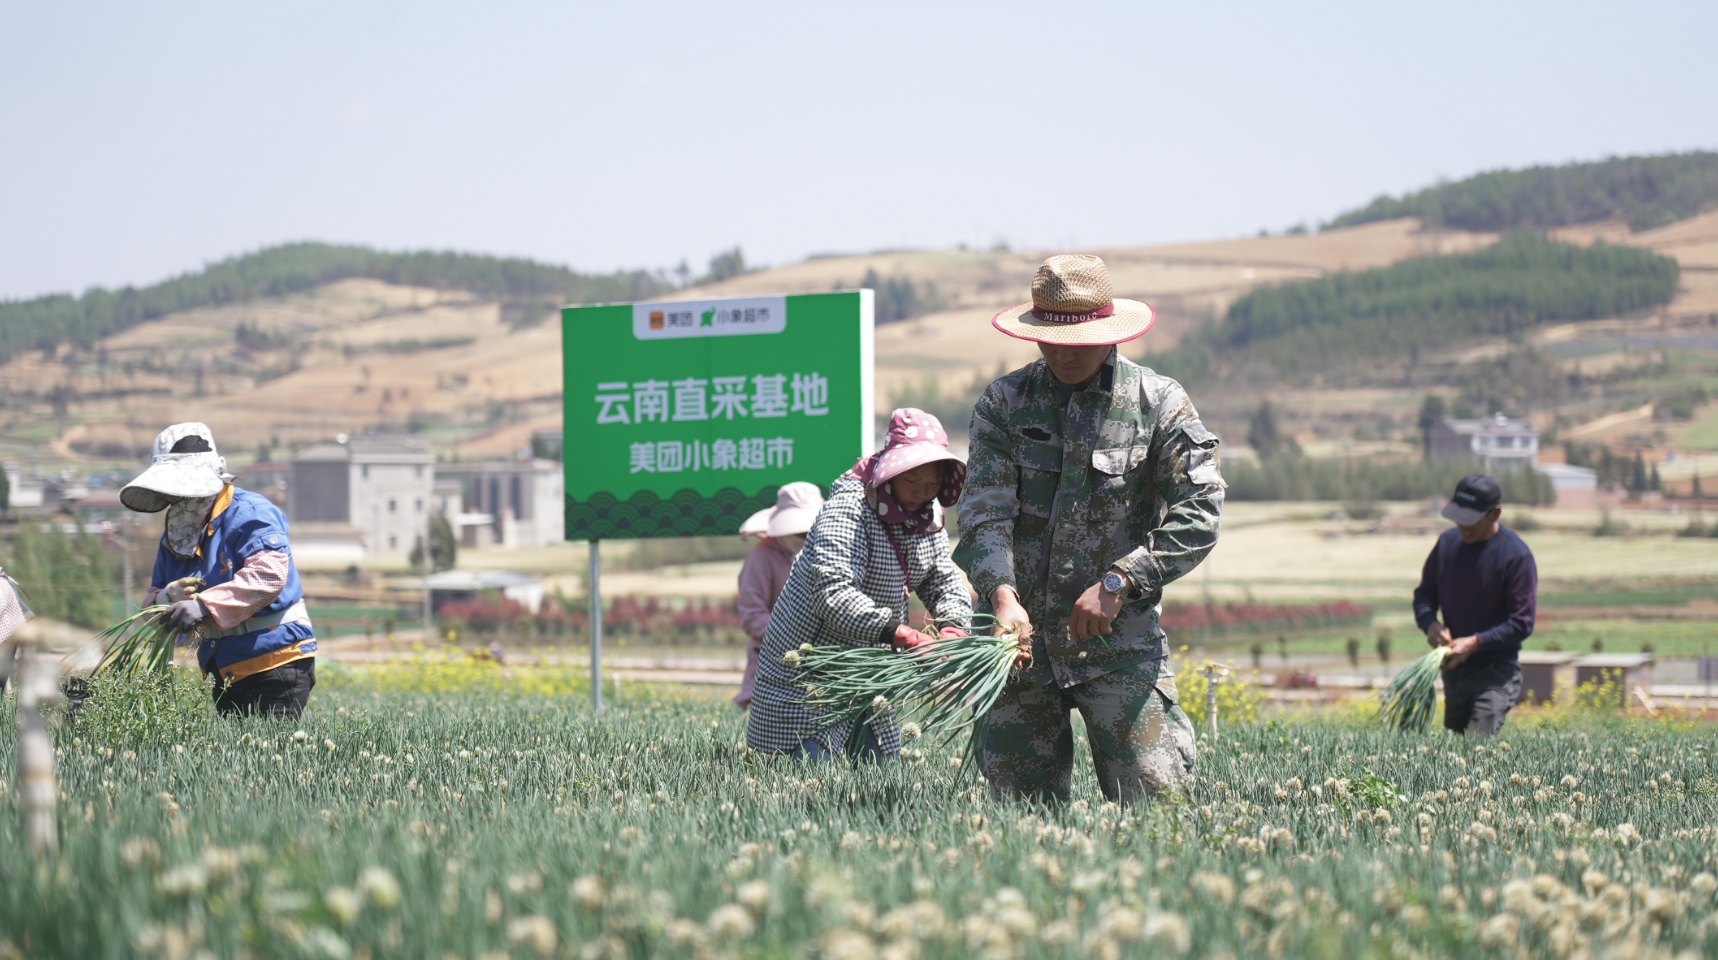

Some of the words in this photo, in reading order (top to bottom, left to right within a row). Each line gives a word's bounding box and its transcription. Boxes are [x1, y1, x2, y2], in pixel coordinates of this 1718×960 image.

[668, 311, 693, 327] 美团
[717, 307, 769, 325] 小象超市
[595, 372, 829, 424] 云南直采基地
[630, 437, 793, 473] 美团小象超市
